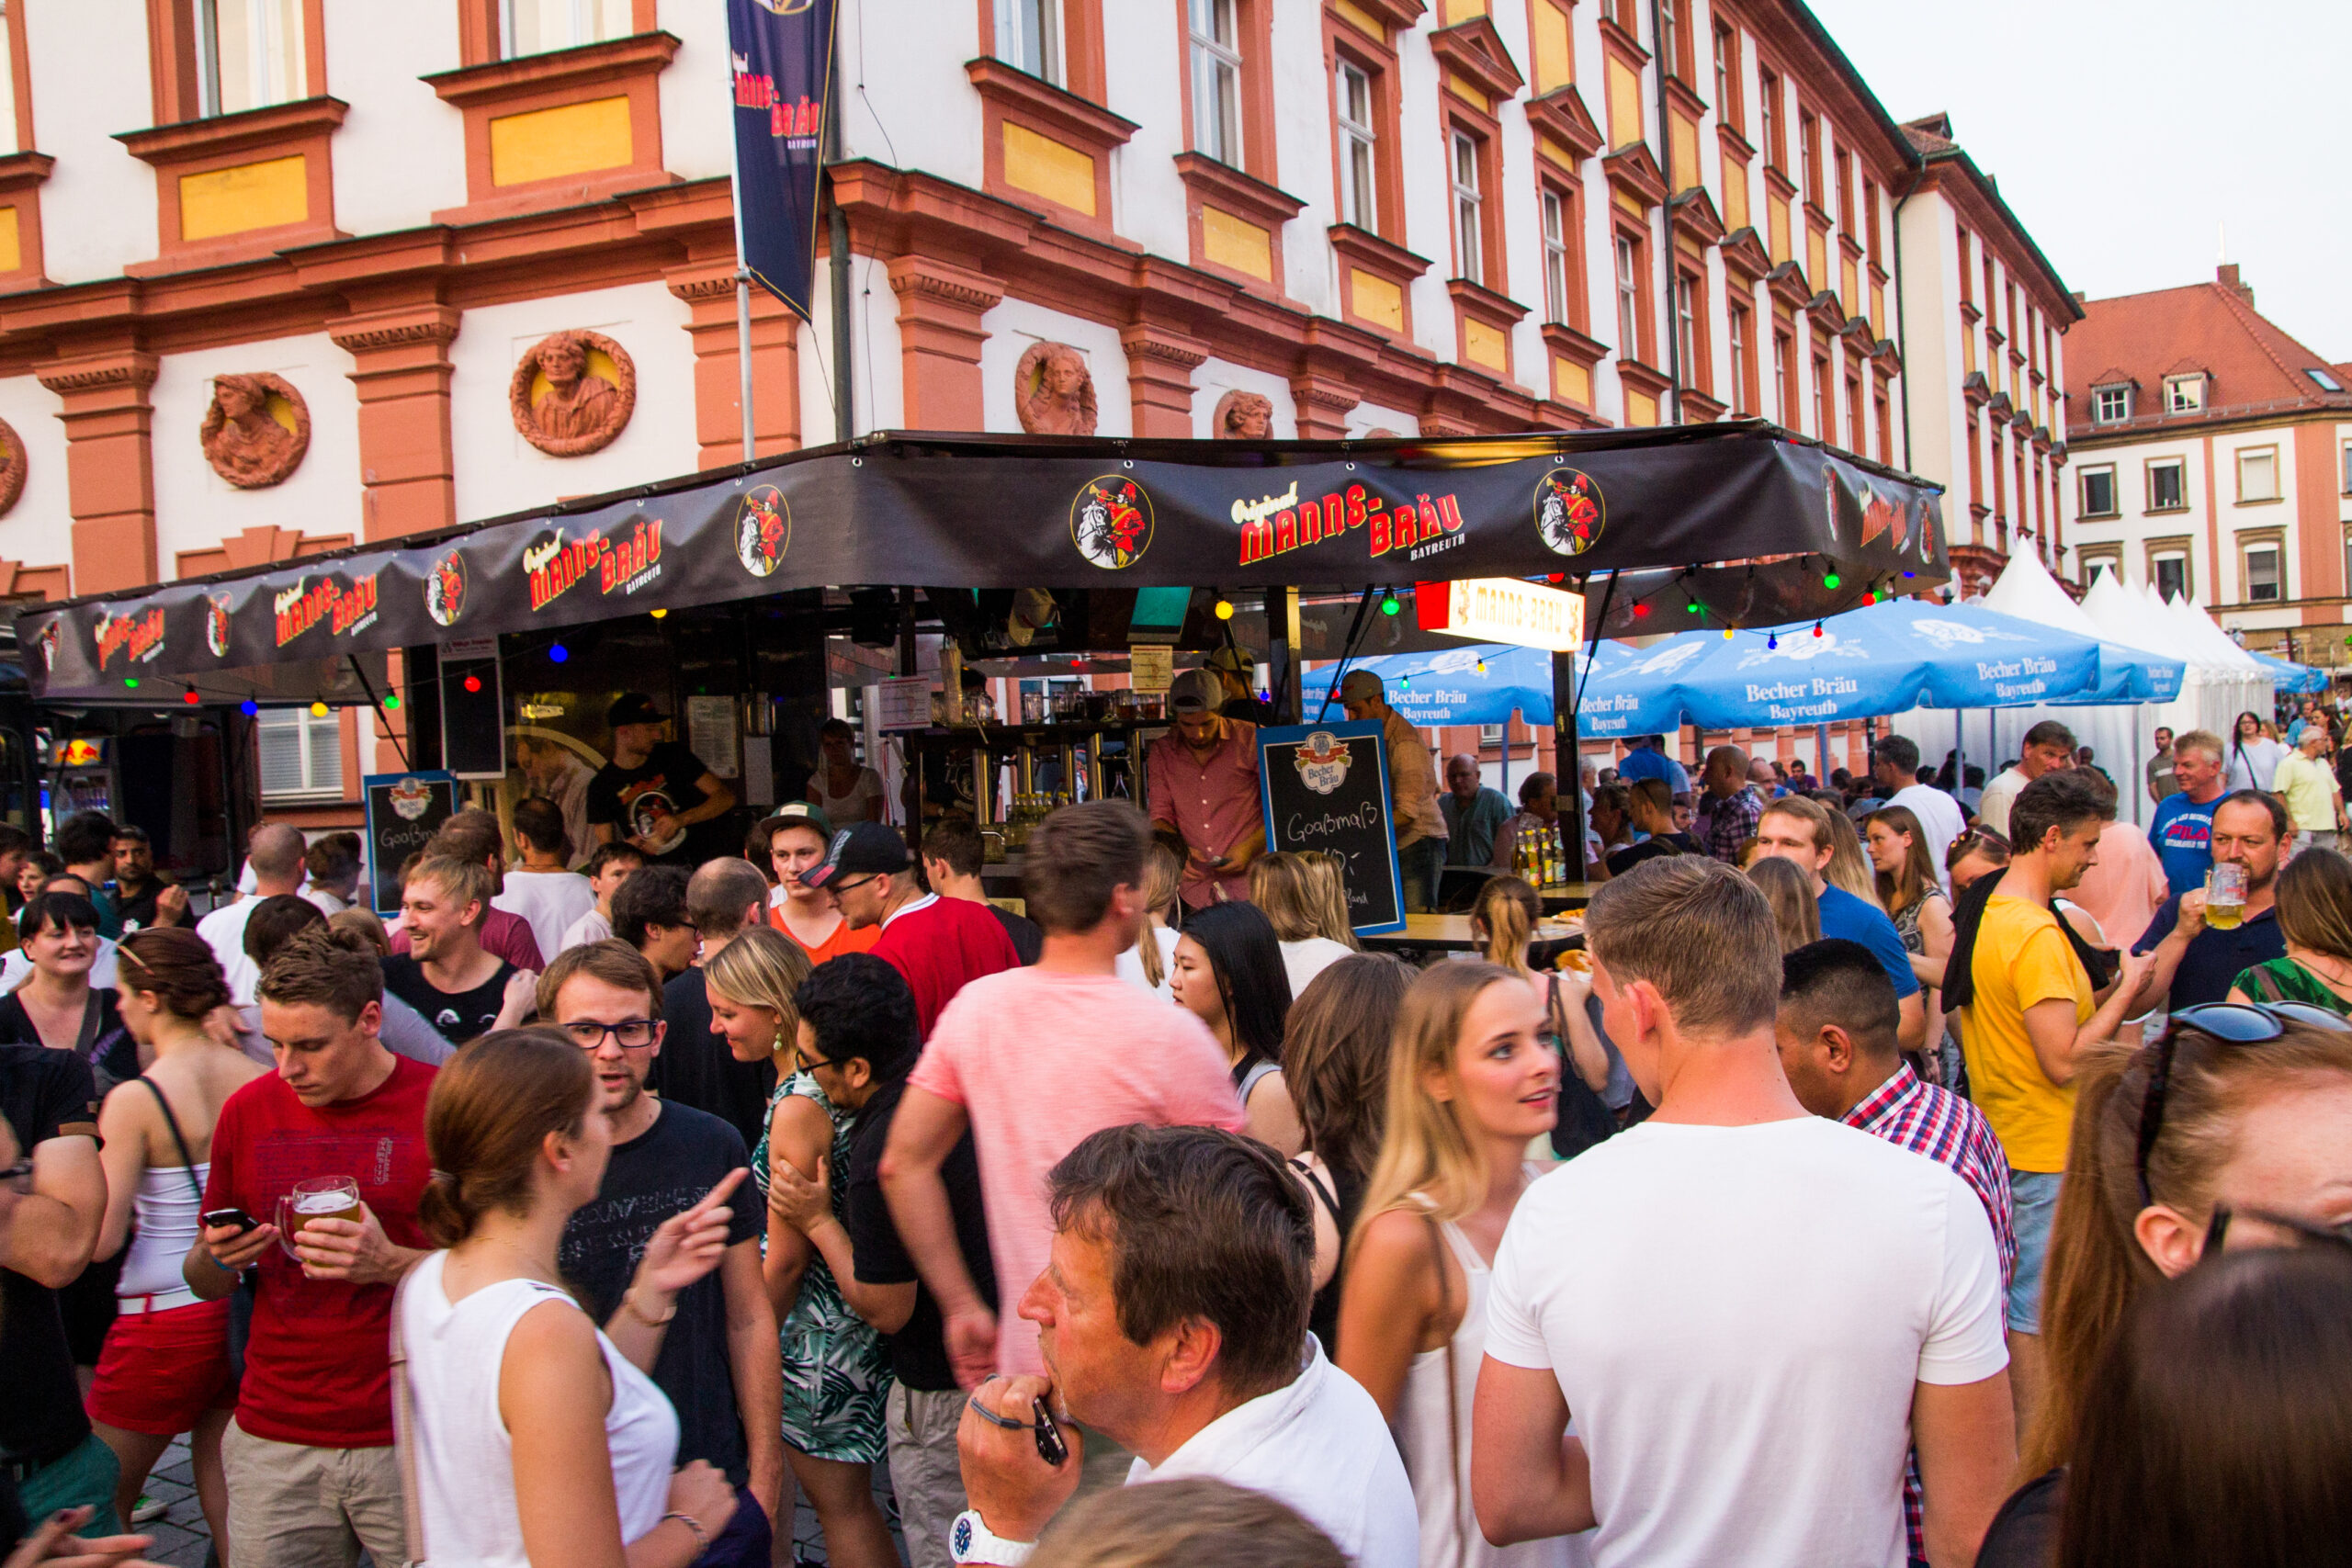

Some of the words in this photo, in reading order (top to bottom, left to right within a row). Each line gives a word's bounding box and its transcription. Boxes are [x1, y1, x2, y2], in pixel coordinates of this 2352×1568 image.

[1231, 480, 1298, 528] Original
[1369, 492, 1464, 558] BRÄU
[601, 519, 662, 595] BRÄU
[1410, 533, 1465, 561] BAYREUTH
[1976, 660, 2021, 681] Becher
[2022, 656, 2057, 674] Bräu
[1388, 690, 1432, 704] Becher
[1435, 690, 1467, 704] Bräu
[1746, 682, 1807, 702] Becher
[1812, 676, 1858, 696] Bräu
[1995, 679, 2046, 699] Bayreuth
[1402, 707, 1451, 722] Bayreuth
[1579, 695, 1613, 713] Becher
[1614, 694, 1639, 711] Bräu
[1770, 699, 1838, 721] Bayreuth
[1308, 765, 1335, 780] Becher
[2167, 825, 2210, 840] FILA
